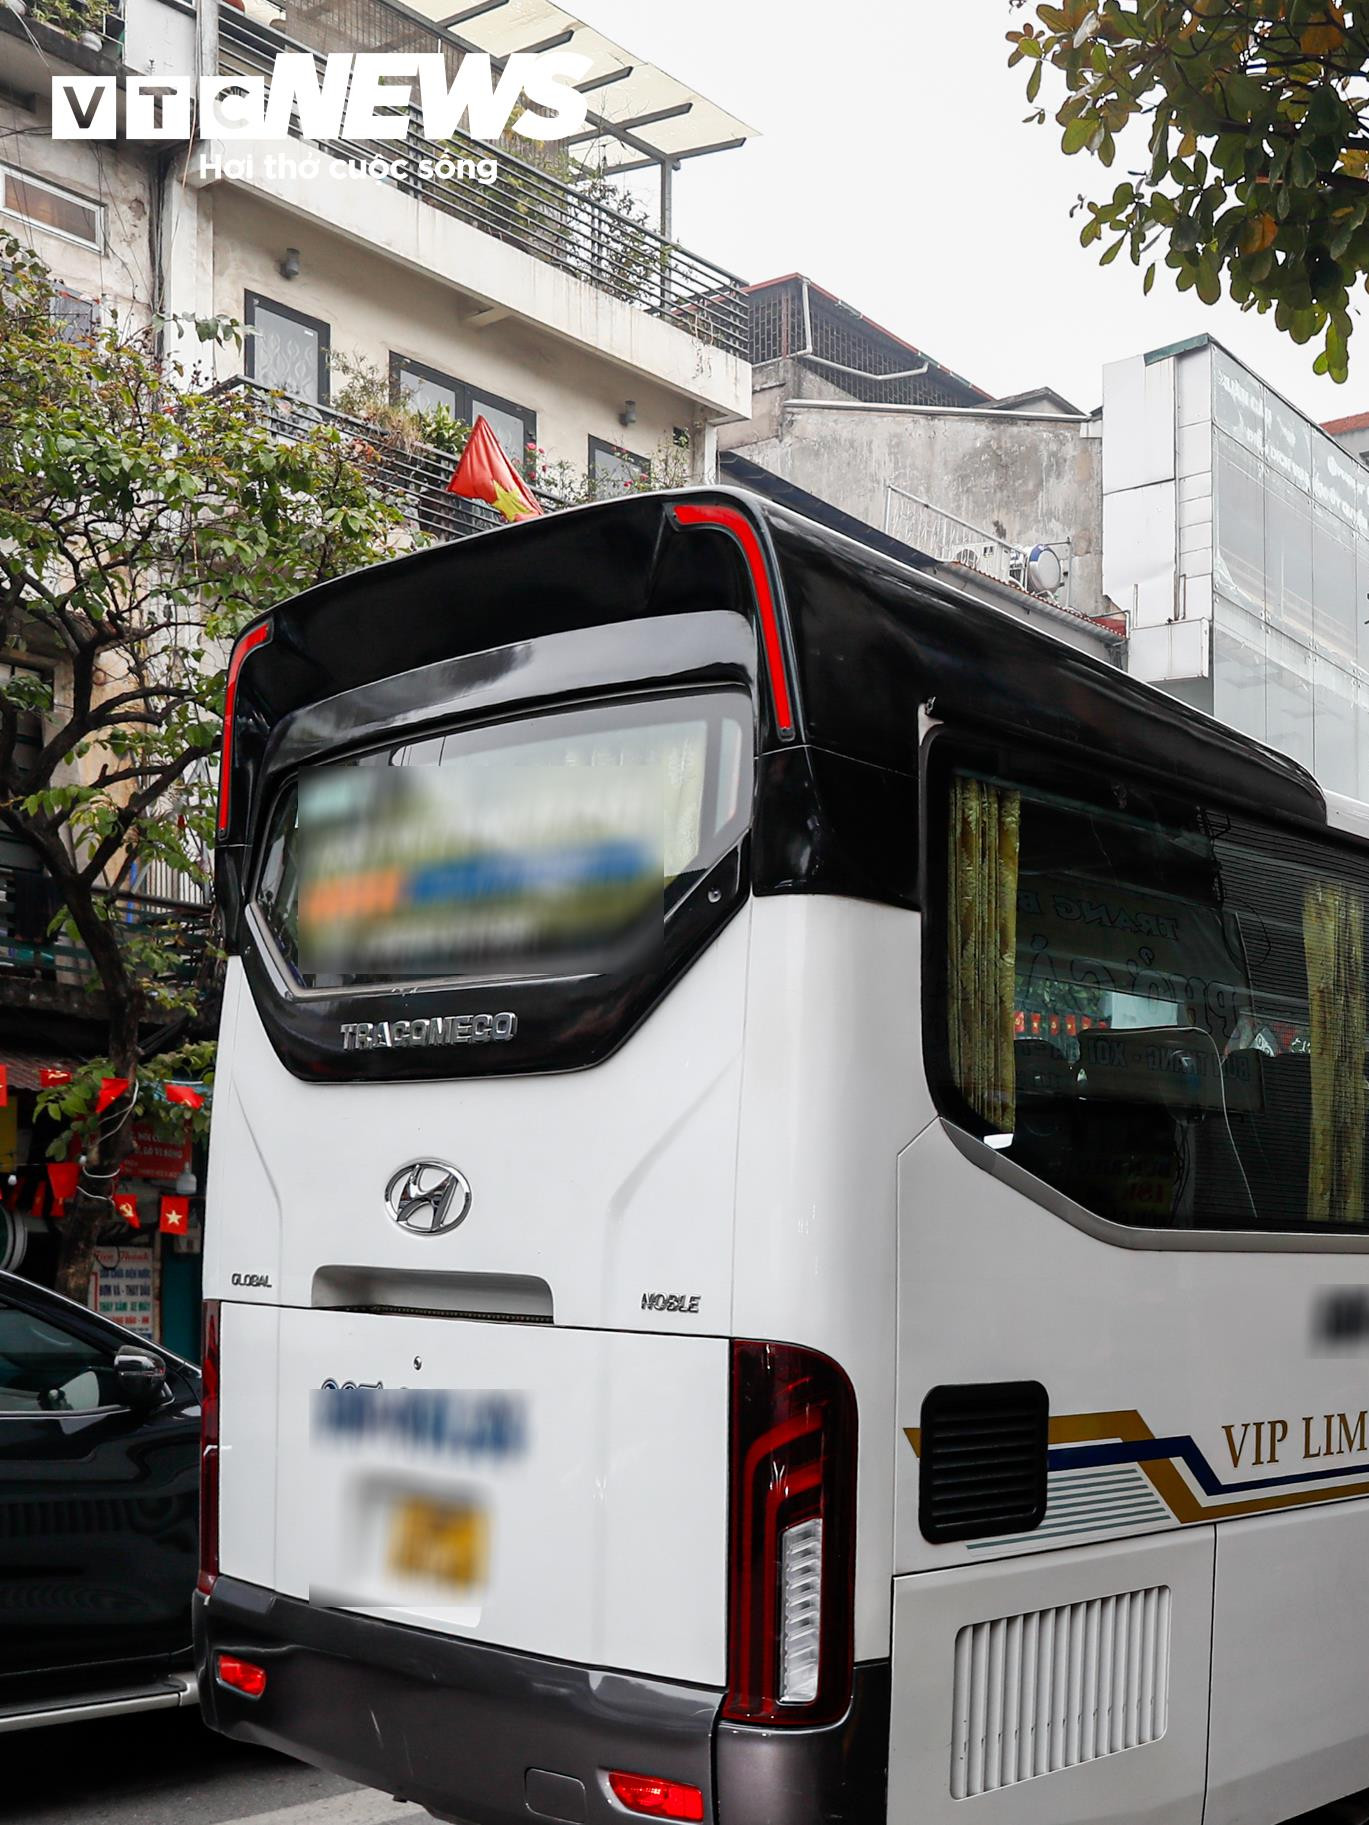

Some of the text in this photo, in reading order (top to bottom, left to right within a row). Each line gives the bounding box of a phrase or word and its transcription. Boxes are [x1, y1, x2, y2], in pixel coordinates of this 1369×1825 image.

[341, 1012, 518, 1050] TRACOMECO
[231, 1273, 272, 1289] GLOBAL
[641, 1293, 701, 1314] NOBLE
[1222, 1419, 1288, 1468] VIP
